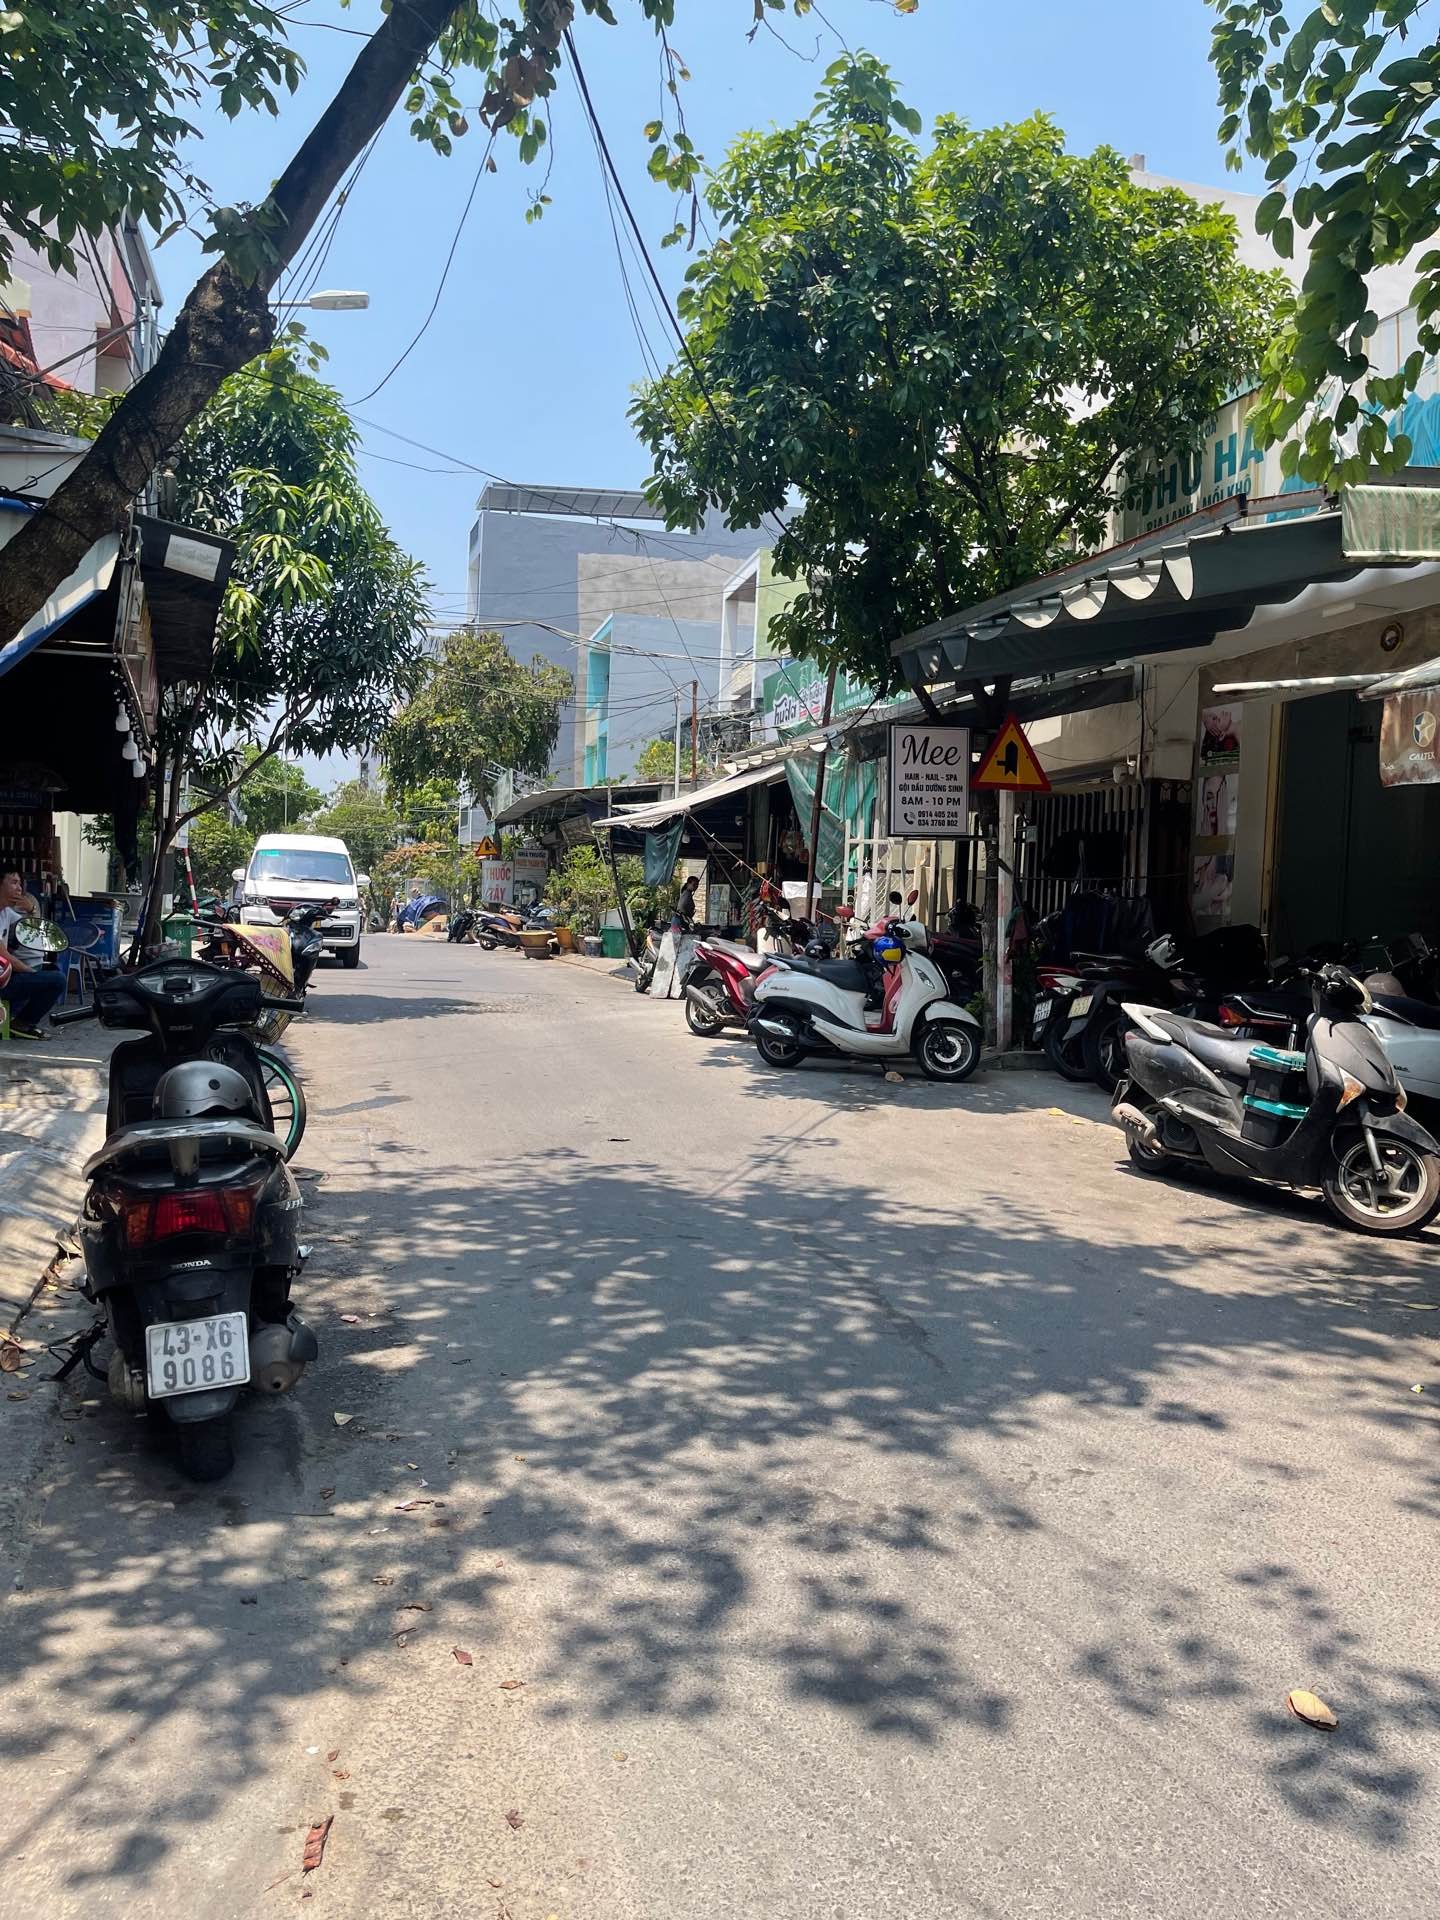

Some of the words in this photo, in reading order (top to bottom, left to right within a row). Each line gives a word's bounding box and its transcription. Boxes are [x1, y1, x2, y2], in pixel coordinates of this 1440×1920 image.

[902, 735, 961, 766] Mee
[1409, 752, 1435, 760] CALTEX
[904, 773, 920, 781] HAIR
[925, 773, 940, 781] NAIL
[901, 796, 923, 805] 8AM
[932, 797, 944, 805] 10
[946, 797, 961, 806] PM
[171, 1259, 212, 1270] HONDA
[163, 1320, 232, 1356] 43-X6
[163, 1351, 234, 1390] 9086
